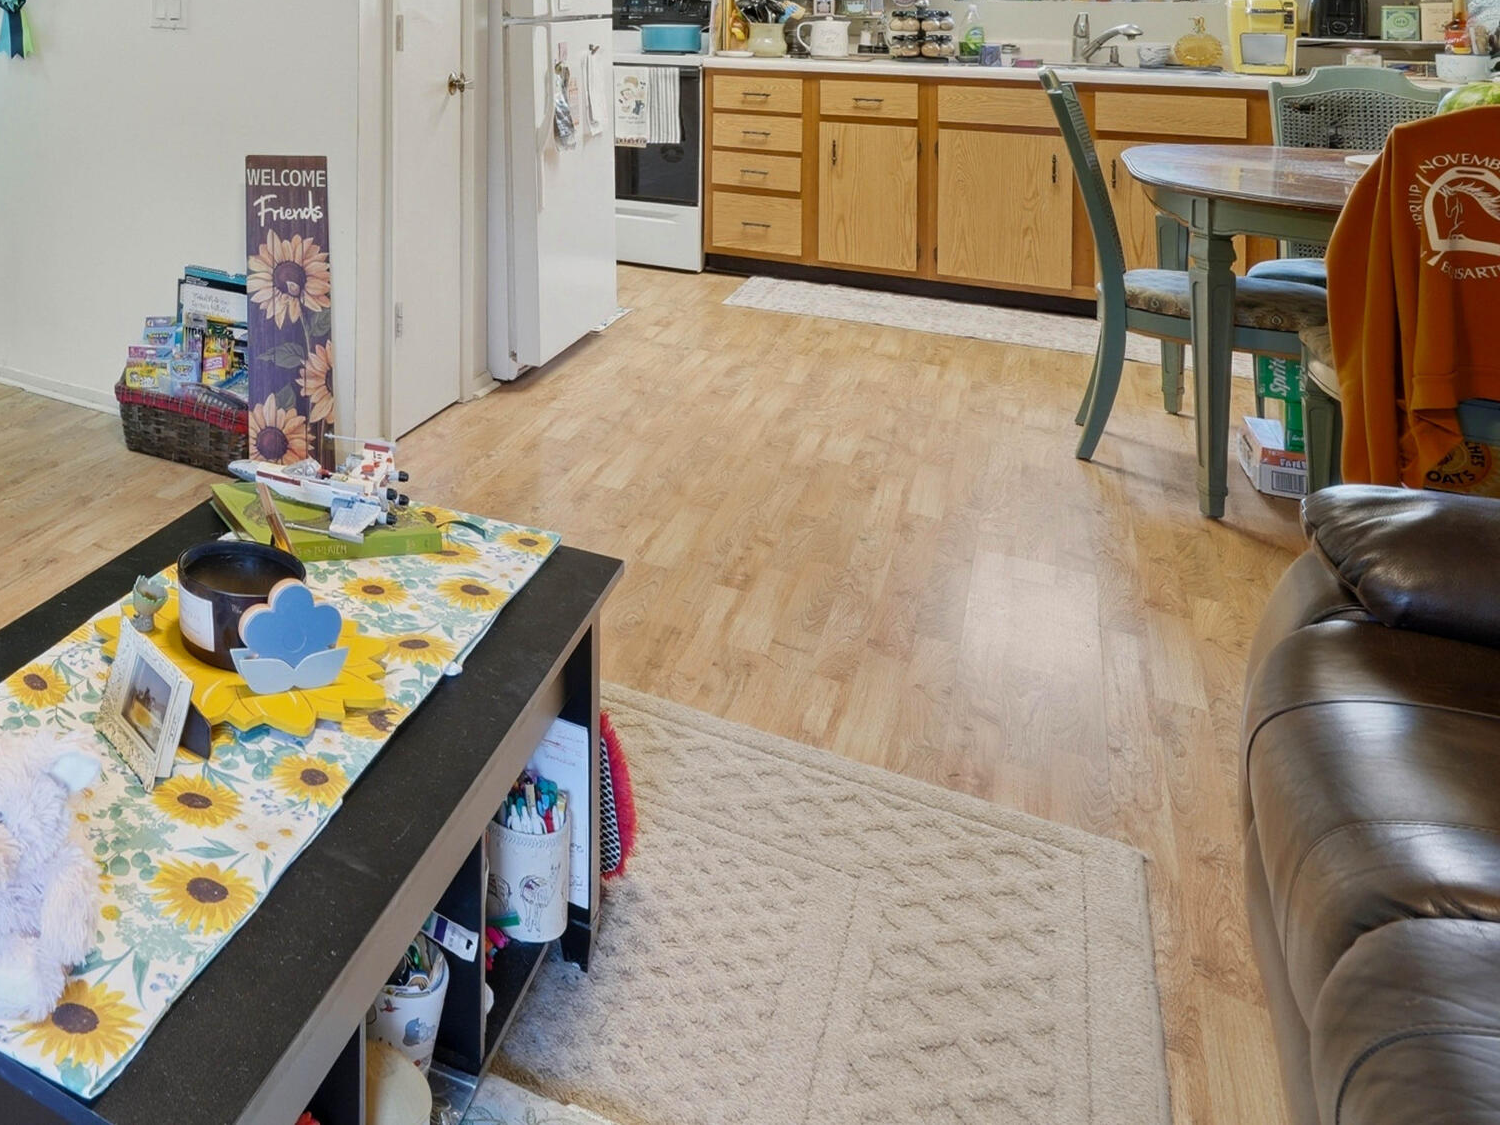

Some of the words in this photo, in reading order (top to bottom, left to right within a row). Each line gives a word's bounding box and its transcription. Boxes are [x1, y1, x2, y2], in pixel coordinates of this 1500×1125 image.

[246, 168, 327, 188] WELCOME
[253, 190, 324, 227] Friends
[1426, 470, 1475, 484] OATS
